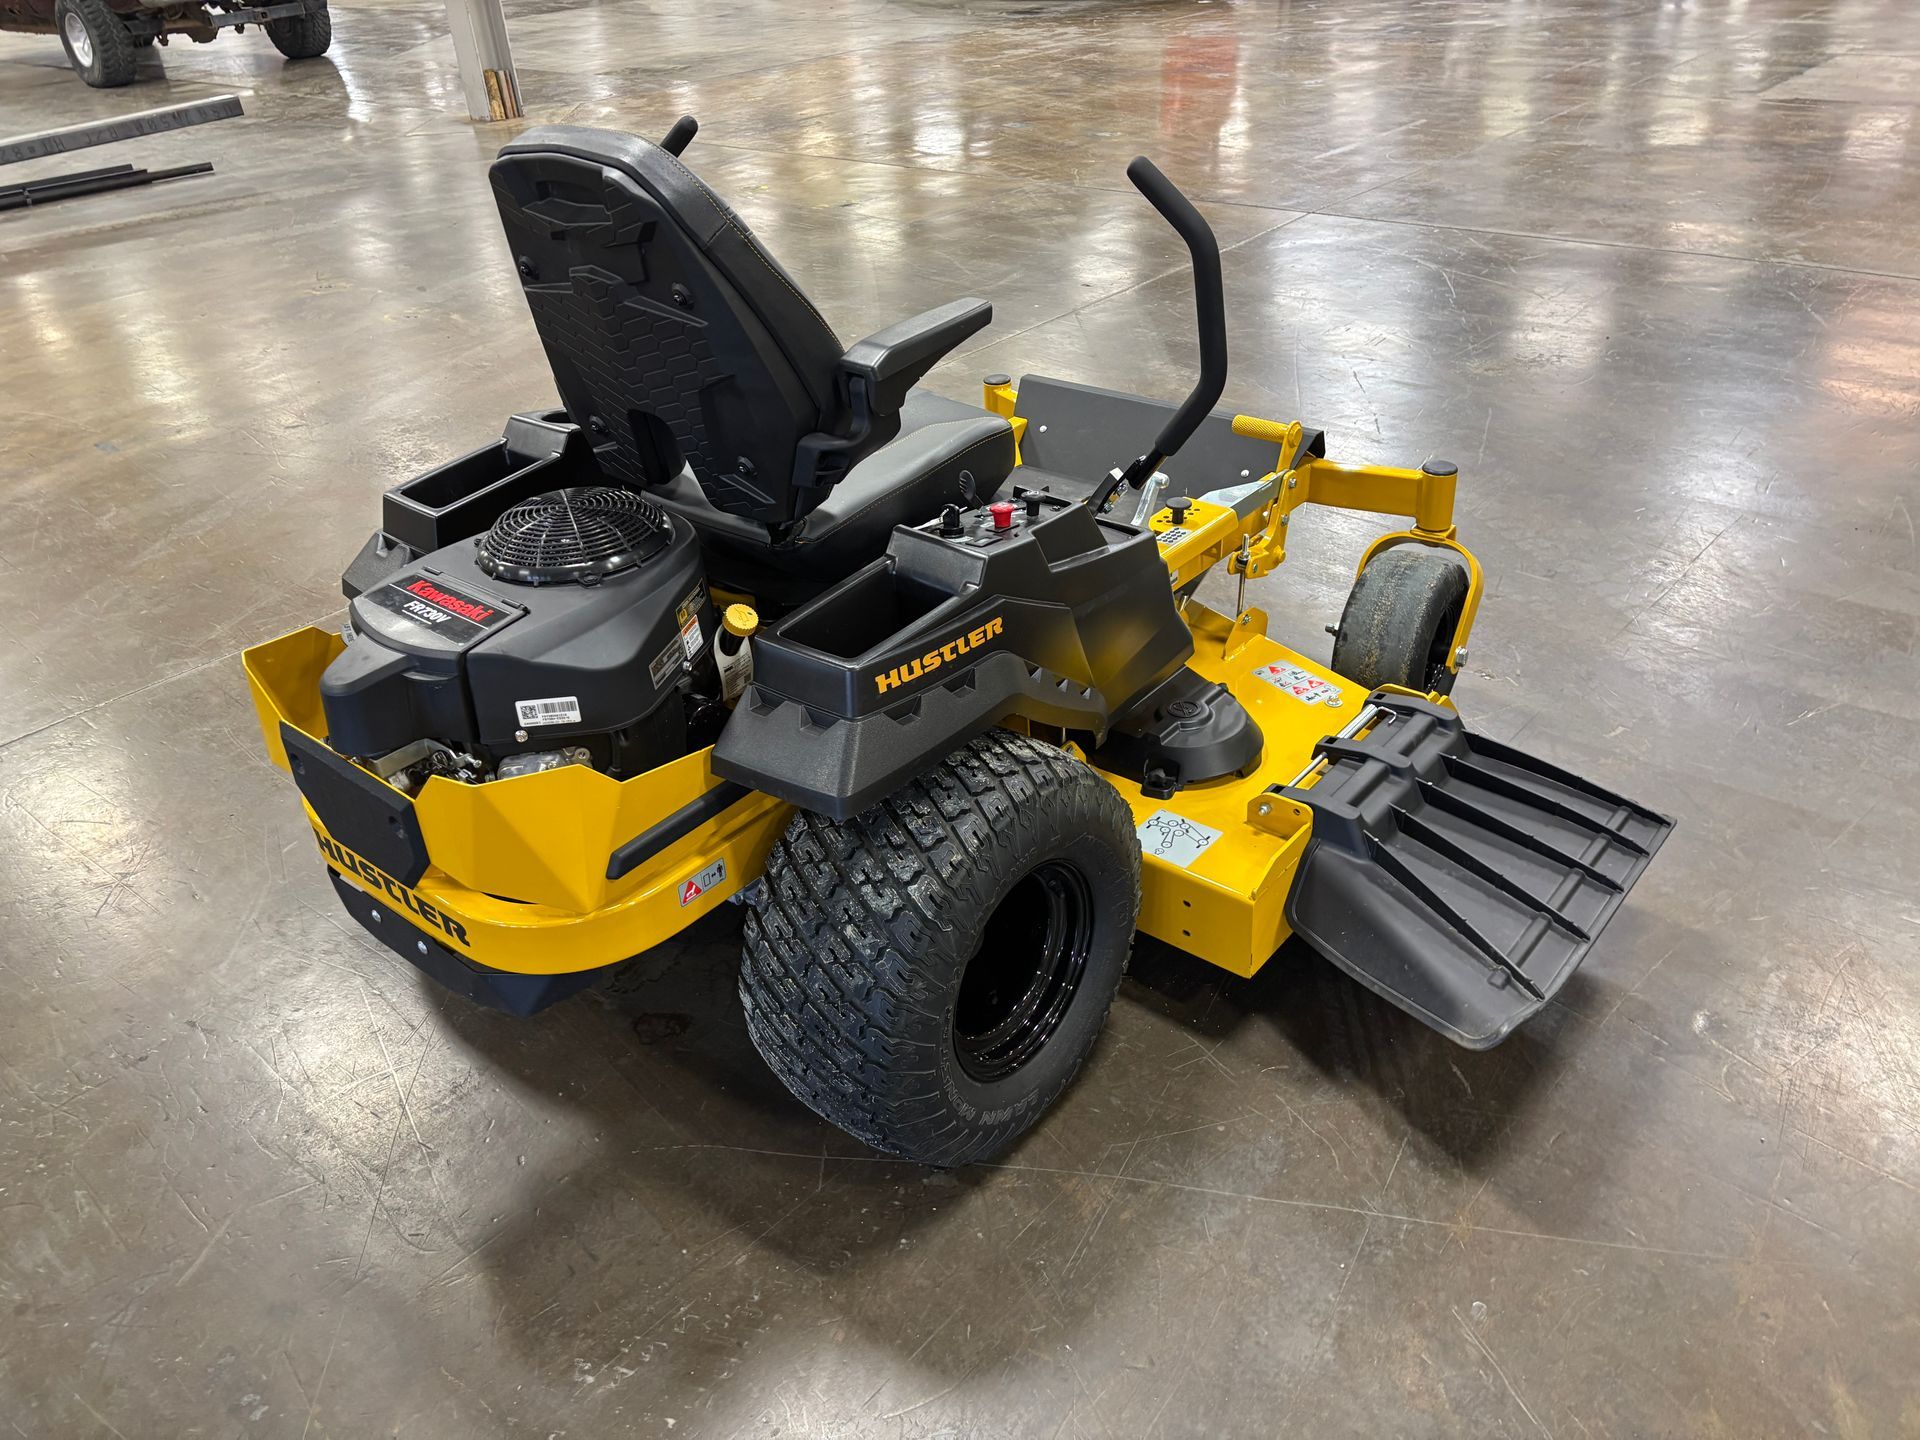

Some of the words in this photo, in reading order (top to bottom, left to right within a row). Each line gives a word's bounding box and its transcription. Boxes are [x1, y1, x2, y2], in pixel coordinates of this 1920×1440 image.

[403, 600, 452, 623] FR730V
[407, 580, 495, 622] Kawasaki
[875, 616, 1003, 694] HUSTLER
[312, 826, 471, 947] HUSTLER
